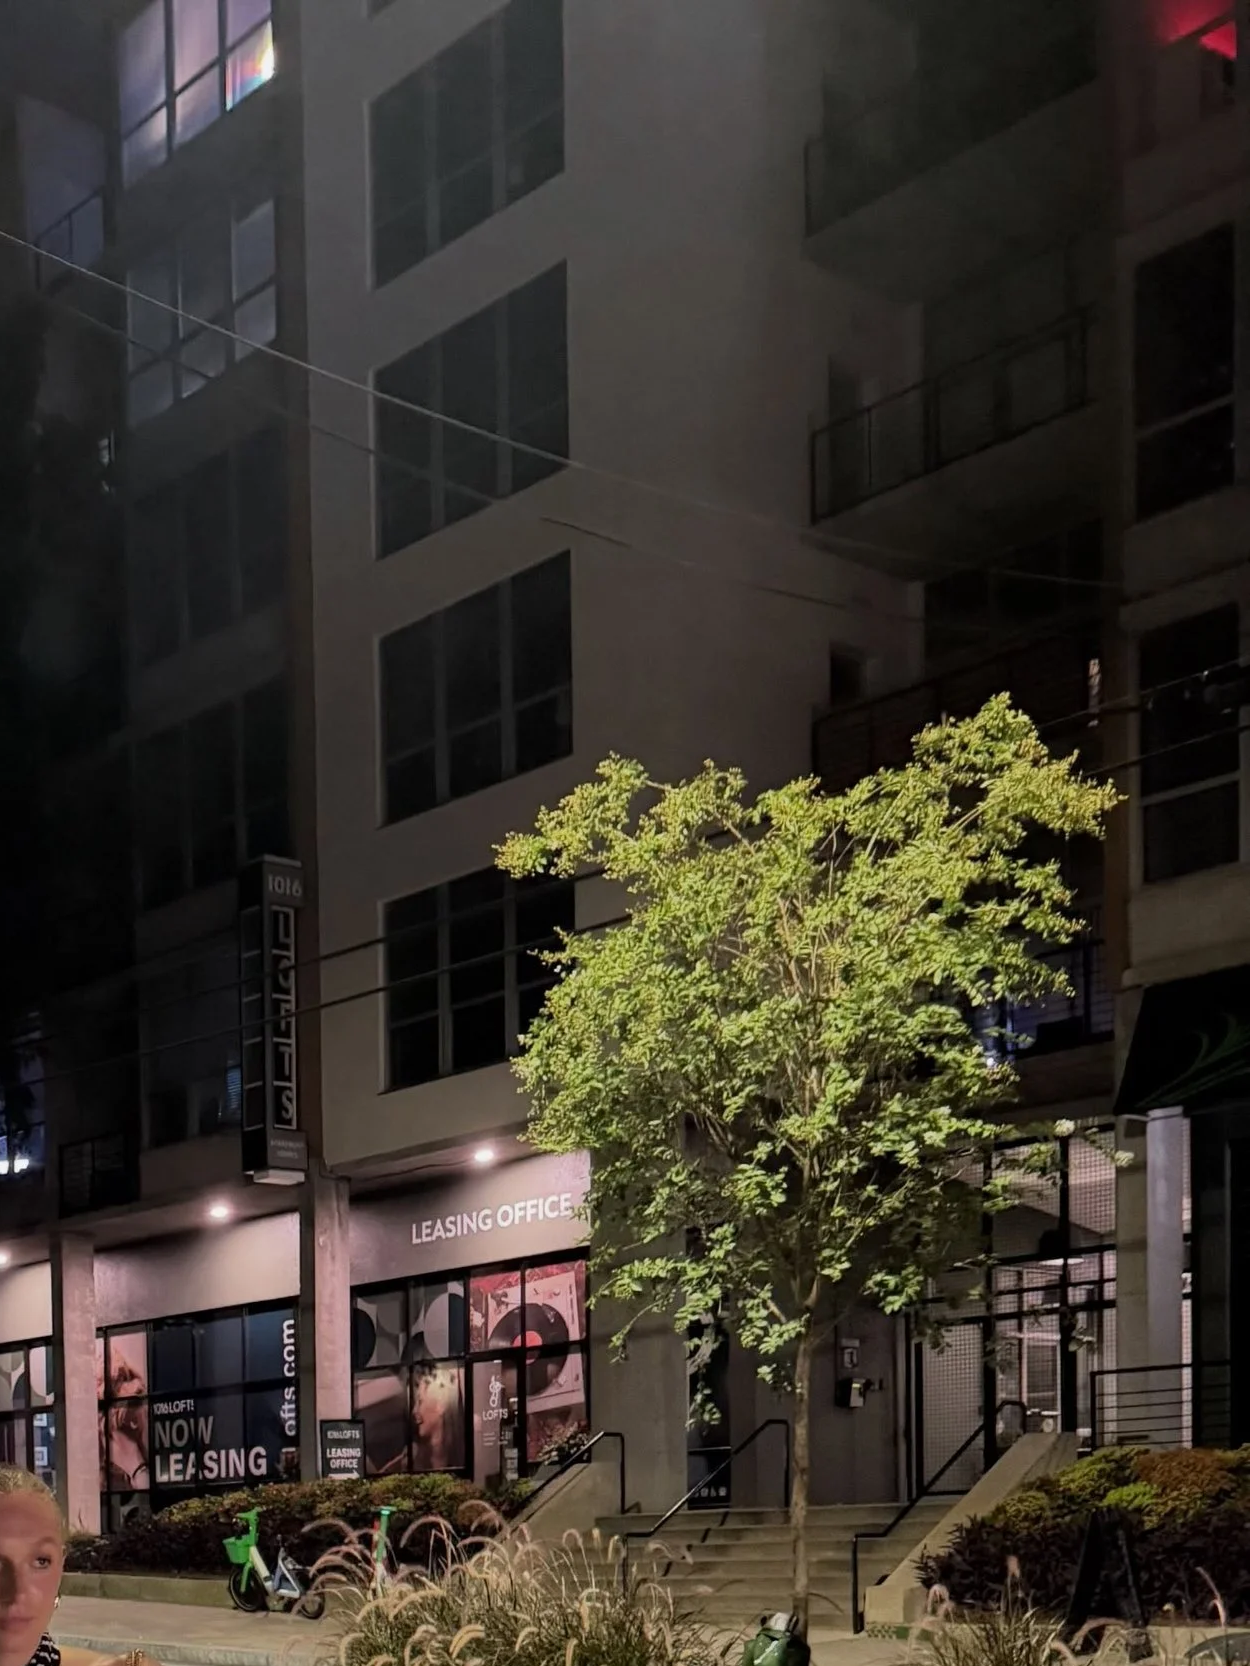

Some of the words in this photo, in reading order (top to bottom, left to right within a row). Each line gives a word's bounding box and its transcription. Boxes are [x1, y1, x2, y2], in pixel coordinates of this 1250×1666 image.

[267, 874, 303, 896] 1016
[411, 1208, 492, 1245] LEASING
[496, 1193, 573, 1228] OFFICE
[482, 1409, 509, 1421] LOFTS
[154, 1416, 214, 1450] NOW
[326, 1447, 361, 1459] LEASING
[330, 1459, 358, 1469] OFFICE
[155, 1446, 267, 1483] LEASING
